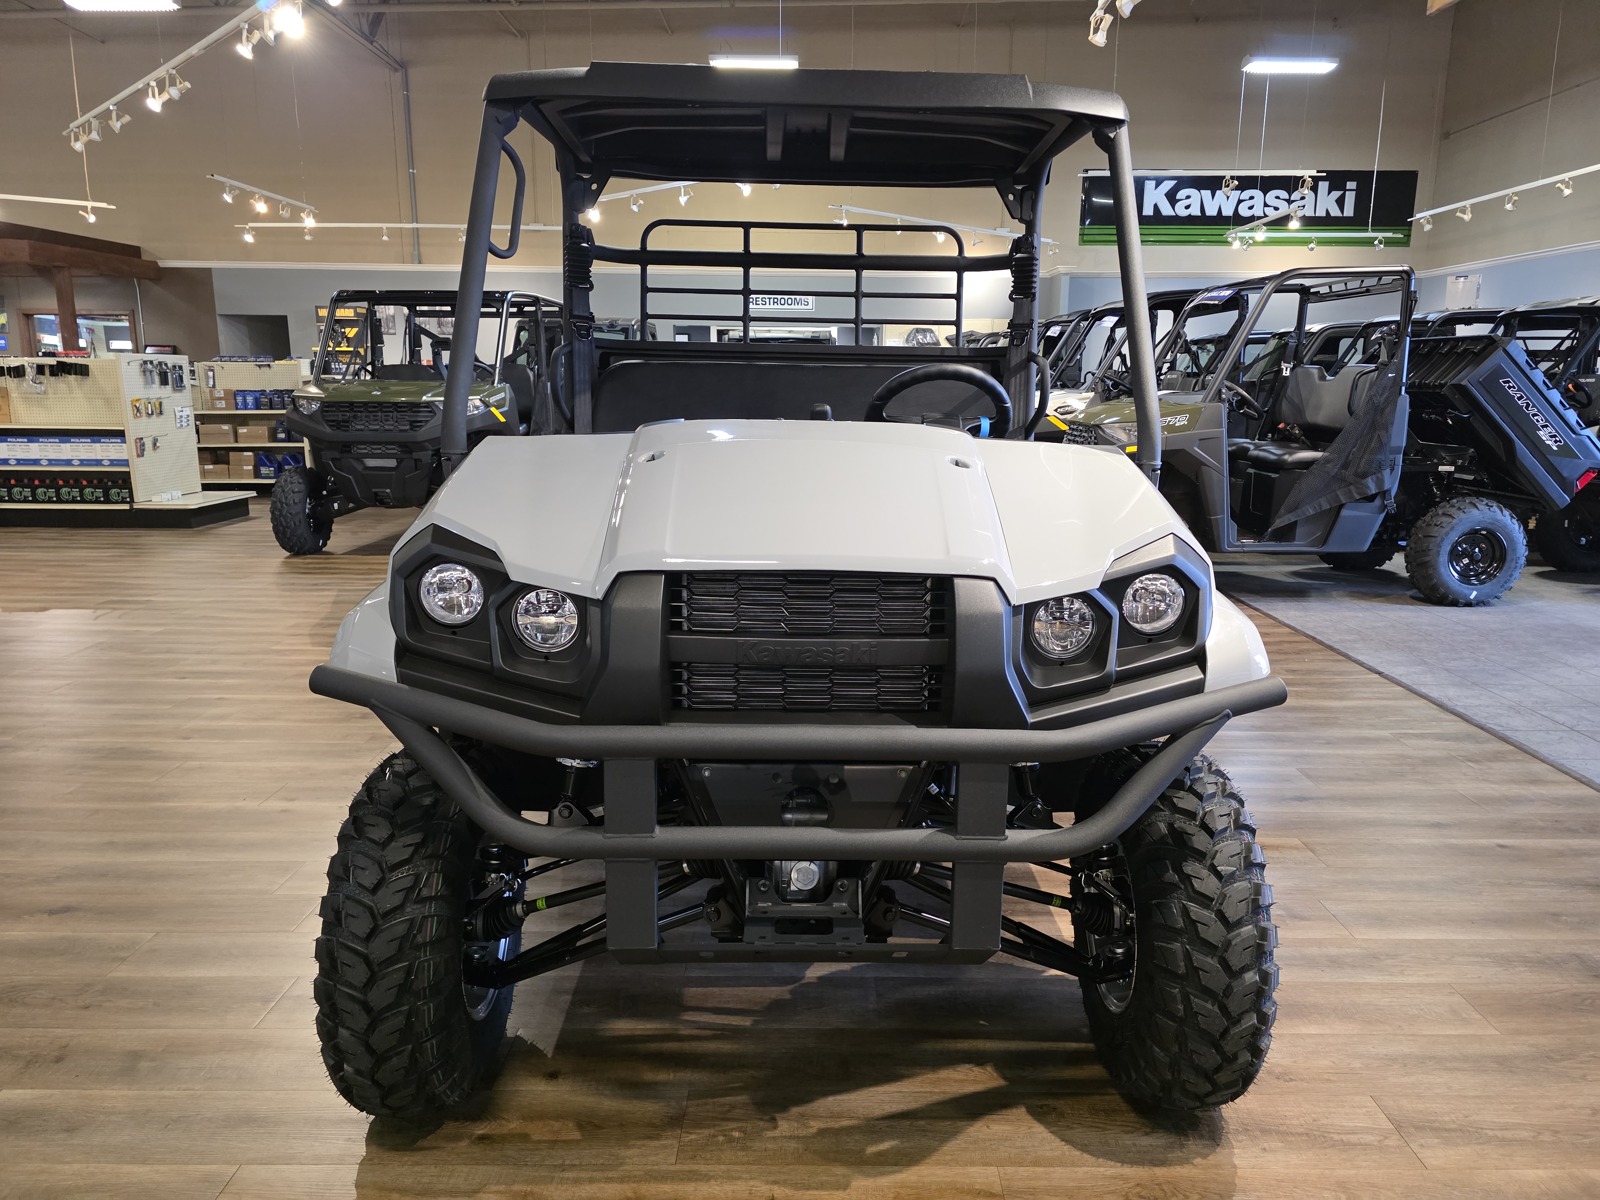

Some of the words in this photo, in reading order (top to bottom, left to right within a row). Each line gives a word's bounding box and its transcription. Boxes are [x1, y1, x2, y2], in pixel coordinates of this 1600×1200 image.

[1142, 180, 1357, 217] Kawasaki
[749, 296, 809, 306] RESTROOMS
[317, 308, 354, 316] VAUARD
[340, 412, 409, 421] POLARIS
[1499, 378, 1563, 446] RANGER
[735, 640, 879, 666] Kawasaki
